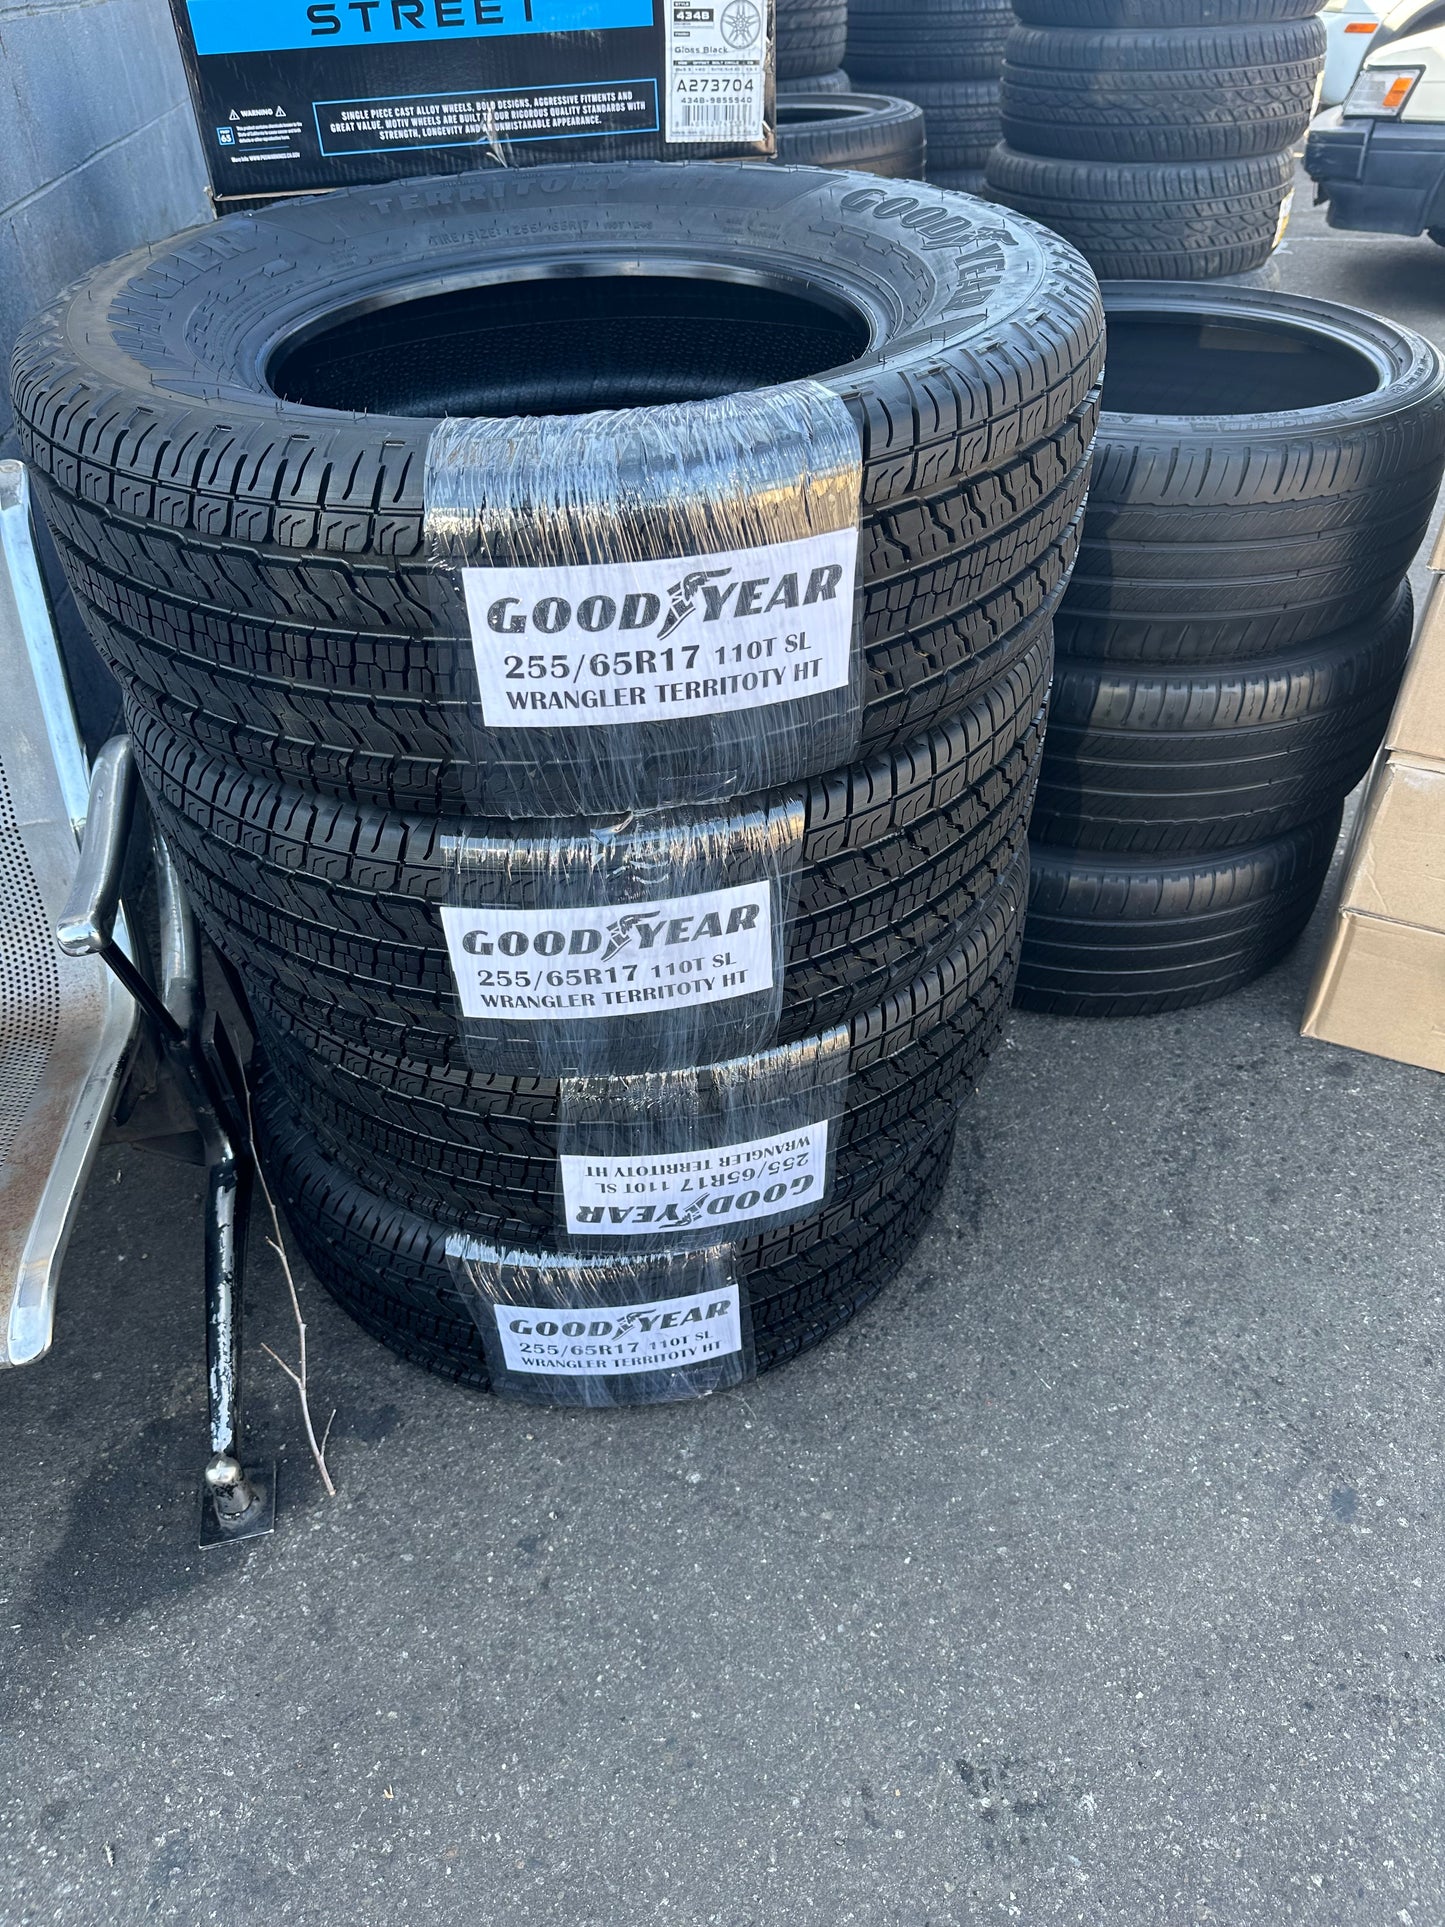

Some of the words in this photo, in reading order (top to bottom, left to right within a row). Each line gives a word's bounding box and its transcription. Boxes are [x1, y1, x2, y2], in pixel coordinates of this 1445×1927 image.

[676, 11, 710, 20] 434B
[674, 46, 700, 54] Gloss
[703, 46, 728, 54] Black
[676, 79, 754, 92] A273704
[240, 109, 273, 117] WARNING
[330, 122, 355, 134] GREAT
[356, 120, 384, 132] VALUE.
[385, 118, 409, 129] MOTIV
[411, 116, 441, 128] WHEELS
[443, 114, 458, 125] ARE
[459, 112, 481, 124] BUILT
[482, 112, 493, 122] TO
[494, 110, 510, 121] OUR
[510, 106, 549, 120] RIGOROUS
[549, 104, 581, 118] QUALITY
[582, 102, 626, 116] STANDARDS
[626, 100, 646, 112] WITH
[341, 109, 370, 122] SINGLE
[370, 107, 393, 119] PIECE
[394, 106, 414, 117] CAST
[416, 105, 440, 116] ALLOY
[441, 102, 475, 114] WHEELS,
[475, 100, 496, 111] BOLD
[497, 98, 532, 110] DESIGNS,
[533, 93, 579, 107] AGGRESSIVE
[580, 91, 616, 104] FITMENTS
[617, 90, 633, 101] AND
[221, 134, 232, 143] 65
[379, 129, 422, 141] STRENGTH,
[422, 125, 463, 138] LONGEVITY
[464, 123, 481, 134] AND
[494, 119, 551, 132] UNMISTAKABLE
[552, 115, 602, 128] APPEARANCE.
[369, 174, 631, 214] TERRITORY
[840, 188, 1012, 312] GOODYEAR
[486, 563, 843, 636] GOODYEAR
[504, 644, 700, 684] 255/65R17
[715, 636, 777, 665] 110T
[784, 631, 812, 654] SL
[505, 686, 646, 711] WRANGLER
[654, 666, 787, 704] TERRITOTY
[794, 658, 824, 681] HT
[462, 903, 760, 958] GOODYEAR
[477, 964, 638, 991] 255/65R17
[651, 957, 704, 979] 110T
[712, 951, 737, 968] SL
[480, 993, 596, 1010] WRANGLER
[601, 977, 716, 1006] TERRITOTY
[722, 969, 750, 988] HT
[718, 1135, 811, 1168] WRANGLER
[584, 1165, 608, 1178] HT
[614, 1158, 710, 1178] TERRITOTY
[680, 1152, 809, 1193] 255/65R17
[575, 1173, 815, 1224] GOODYEAR
[595, 1181, 617, 1194] SL
[622, 1179, 671, 1194] 110T
[509, 1299, 732, 1338] GOODYEAR
[519, 1341, 640, 1358] 255/65R17
[649, 1336, 689, 1350] 110T
[695, 1329, 713, 1342] SL
[520, 1356, 607, 1369] WRANGLER
[611, 1347, 699, 1368] TERRITOTY
[702, 1340, 723, 1353] HT
